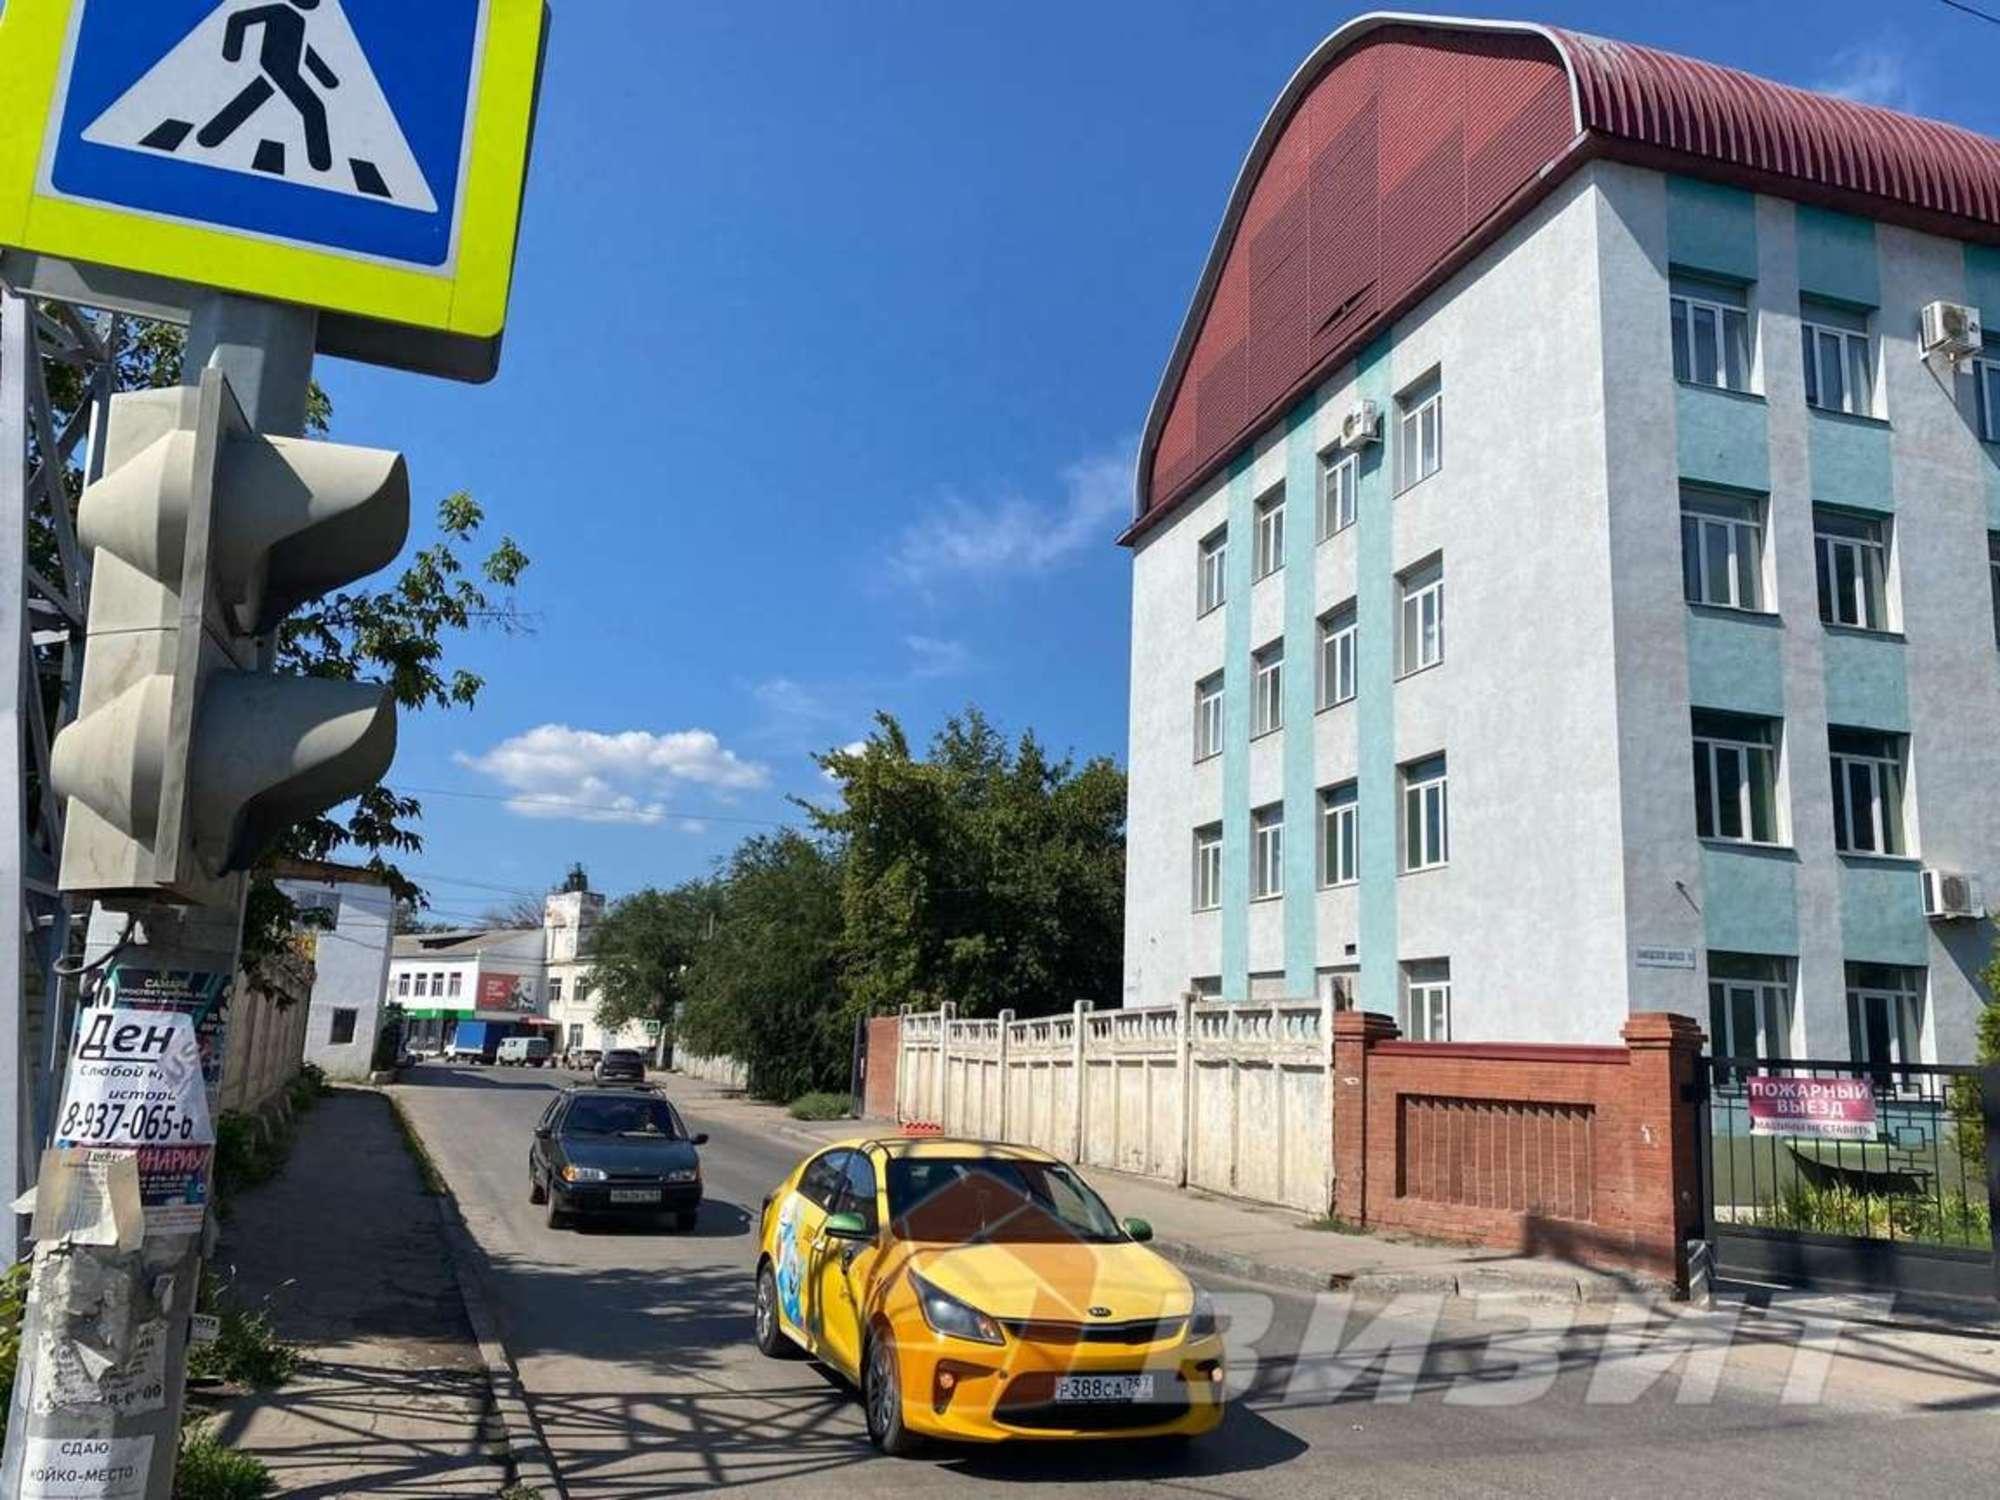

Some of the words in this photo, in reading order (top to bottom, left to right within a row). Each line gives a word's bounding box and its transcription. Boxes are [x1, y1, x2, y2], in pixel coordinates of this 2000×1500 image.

[1751, 1082, 1869, 1100] ПОЖАРНЫЙ
[1777, 1100, 1845, 1119] ВЫЕЗД
[61, 1442, 109, 1456] СДАЮ
